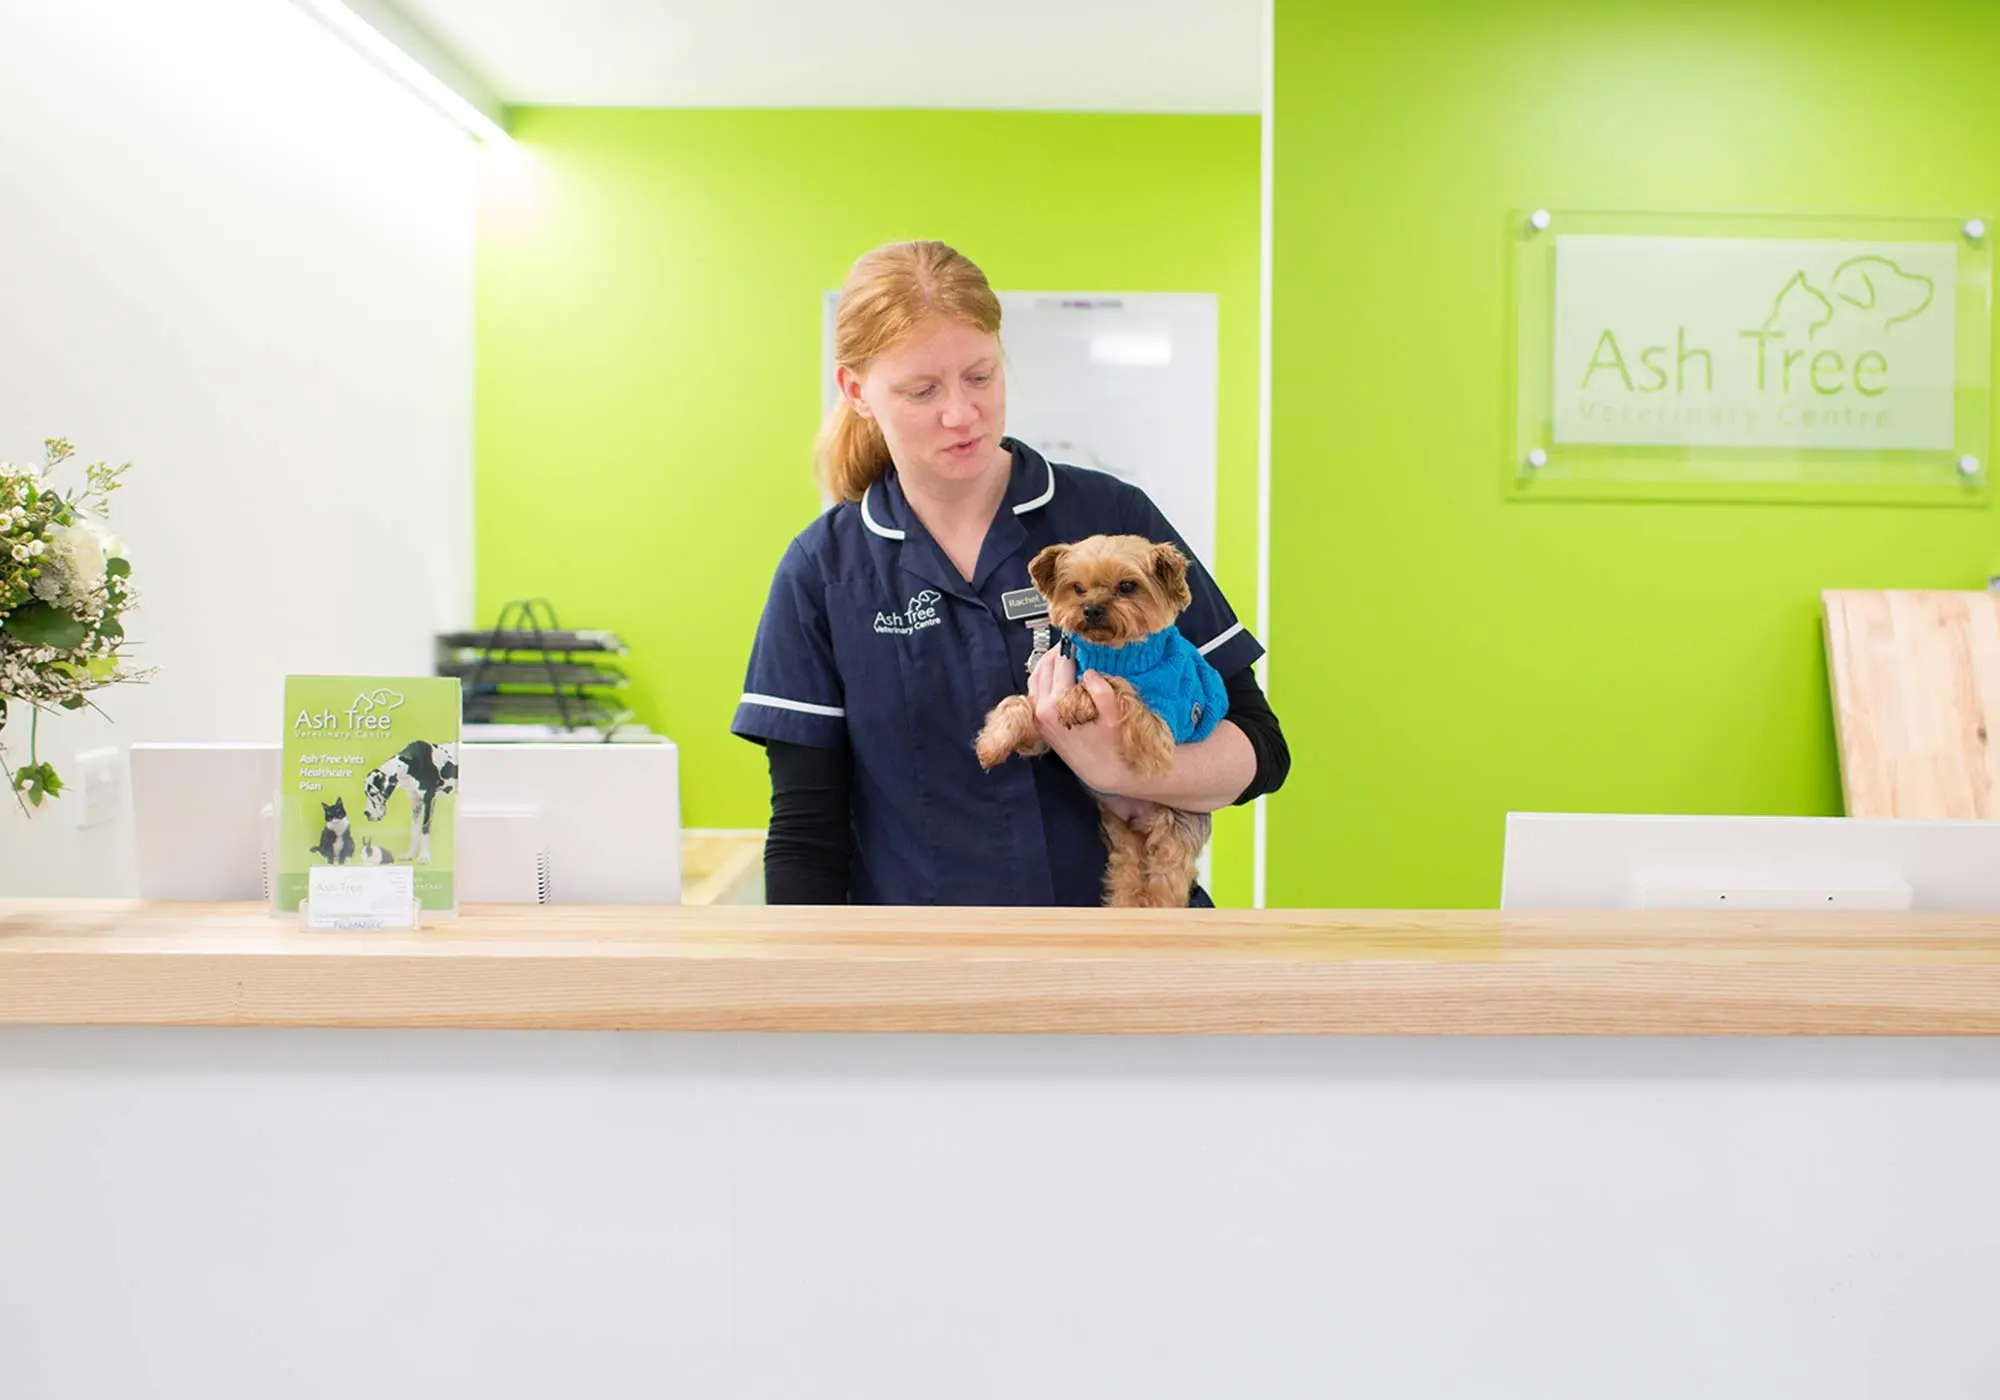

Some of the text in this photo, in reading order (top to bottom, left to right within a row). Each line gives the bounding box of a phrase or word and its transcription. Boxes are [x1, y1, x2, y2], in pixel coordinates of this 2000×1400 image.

[1580, 325, 1890, 397] Ash Tree
[1578, 401, 1892, 430] Veterinary Centre
[1008, 593, 1040, 608] Rachel
[873, 606, 936, 628] Ash Tree
[874, 617, 942, 635] Veterinary Centre
[295, 709, 391, 730] Ash Tree
[294, 730, 392, 740] Veterinary Centre
[299, 754, 364, 764] Ash Tree Vets
[300, 768, 353, 778] Healthcare
[300, 781, 322, 791] Plan
